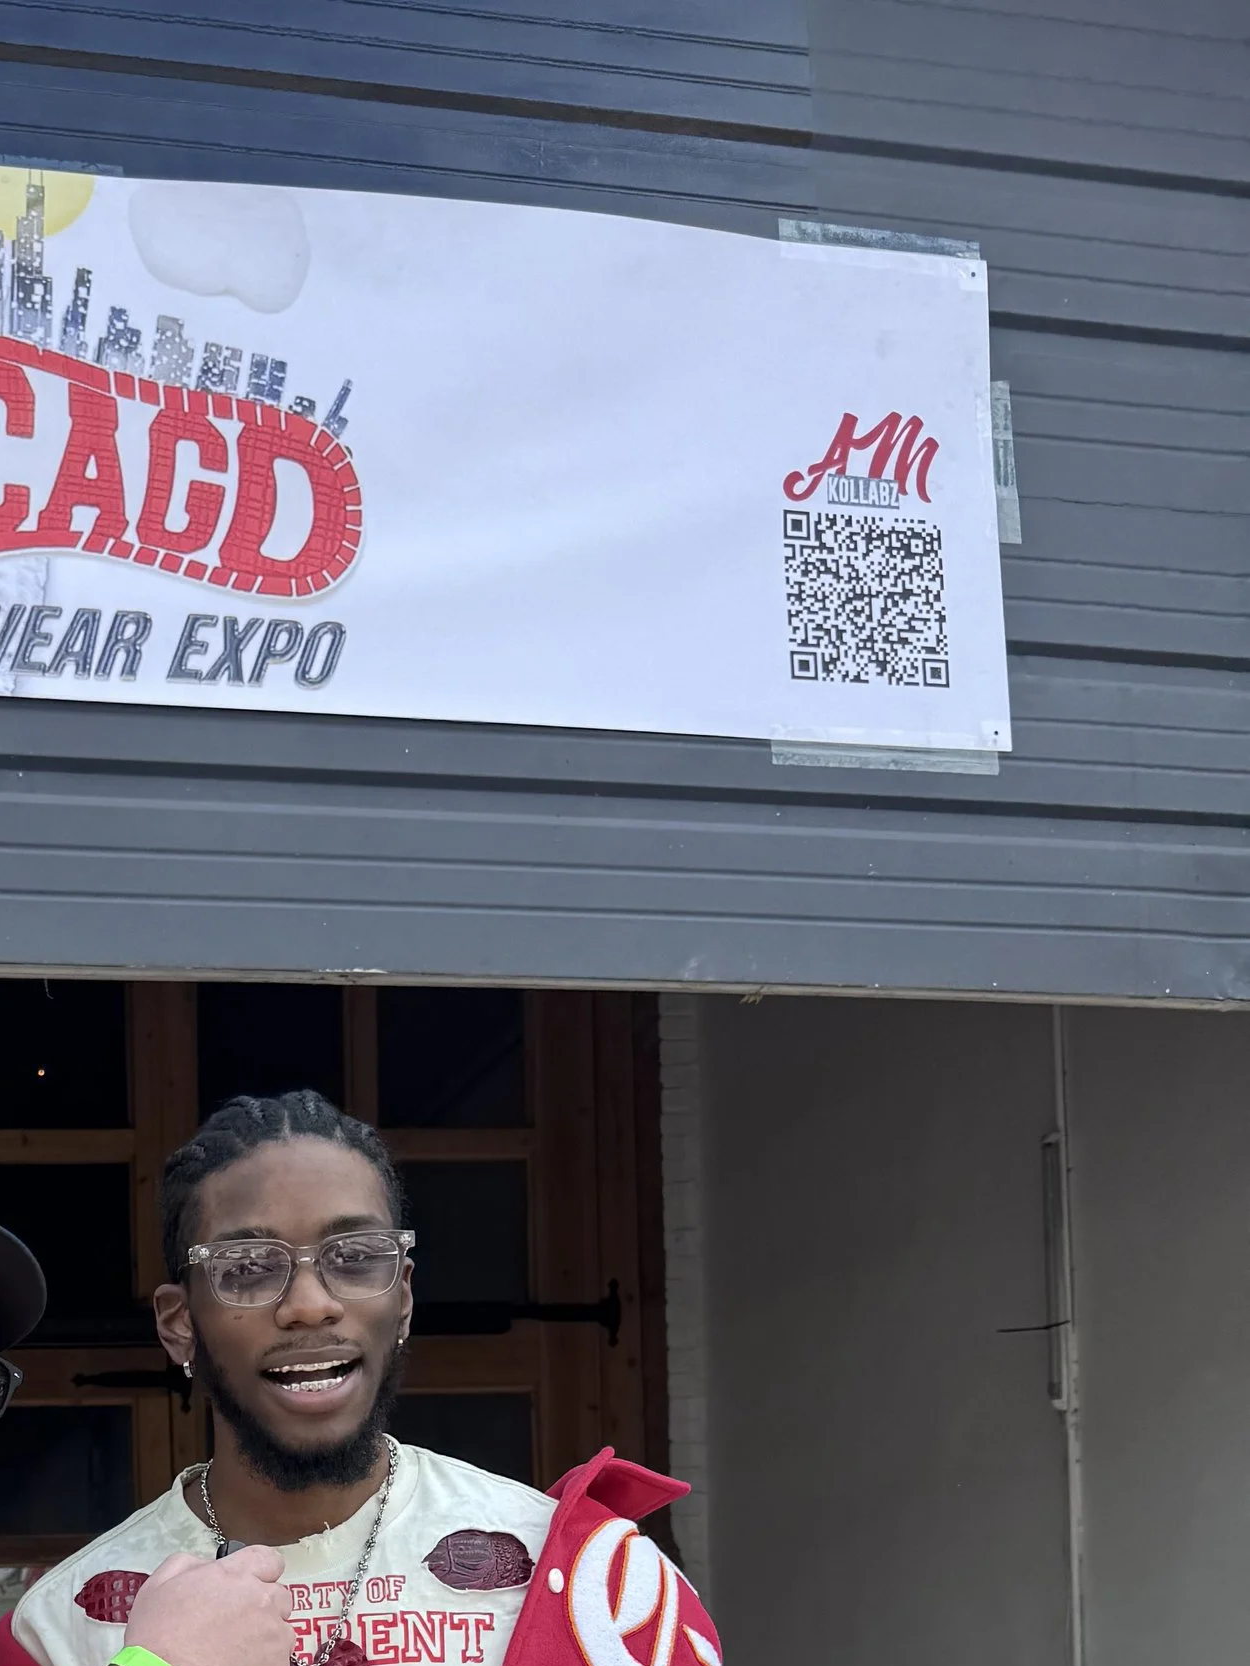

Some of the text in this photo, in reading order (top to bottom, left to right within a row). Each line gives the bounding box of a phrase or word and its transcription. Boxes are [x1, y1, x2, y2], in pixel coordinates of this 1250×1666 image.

[827, 475, 900, 507] KOLLABZ
[166, 612, 346, 689] EXPO
[366, 1575, 406, 1603] OF
